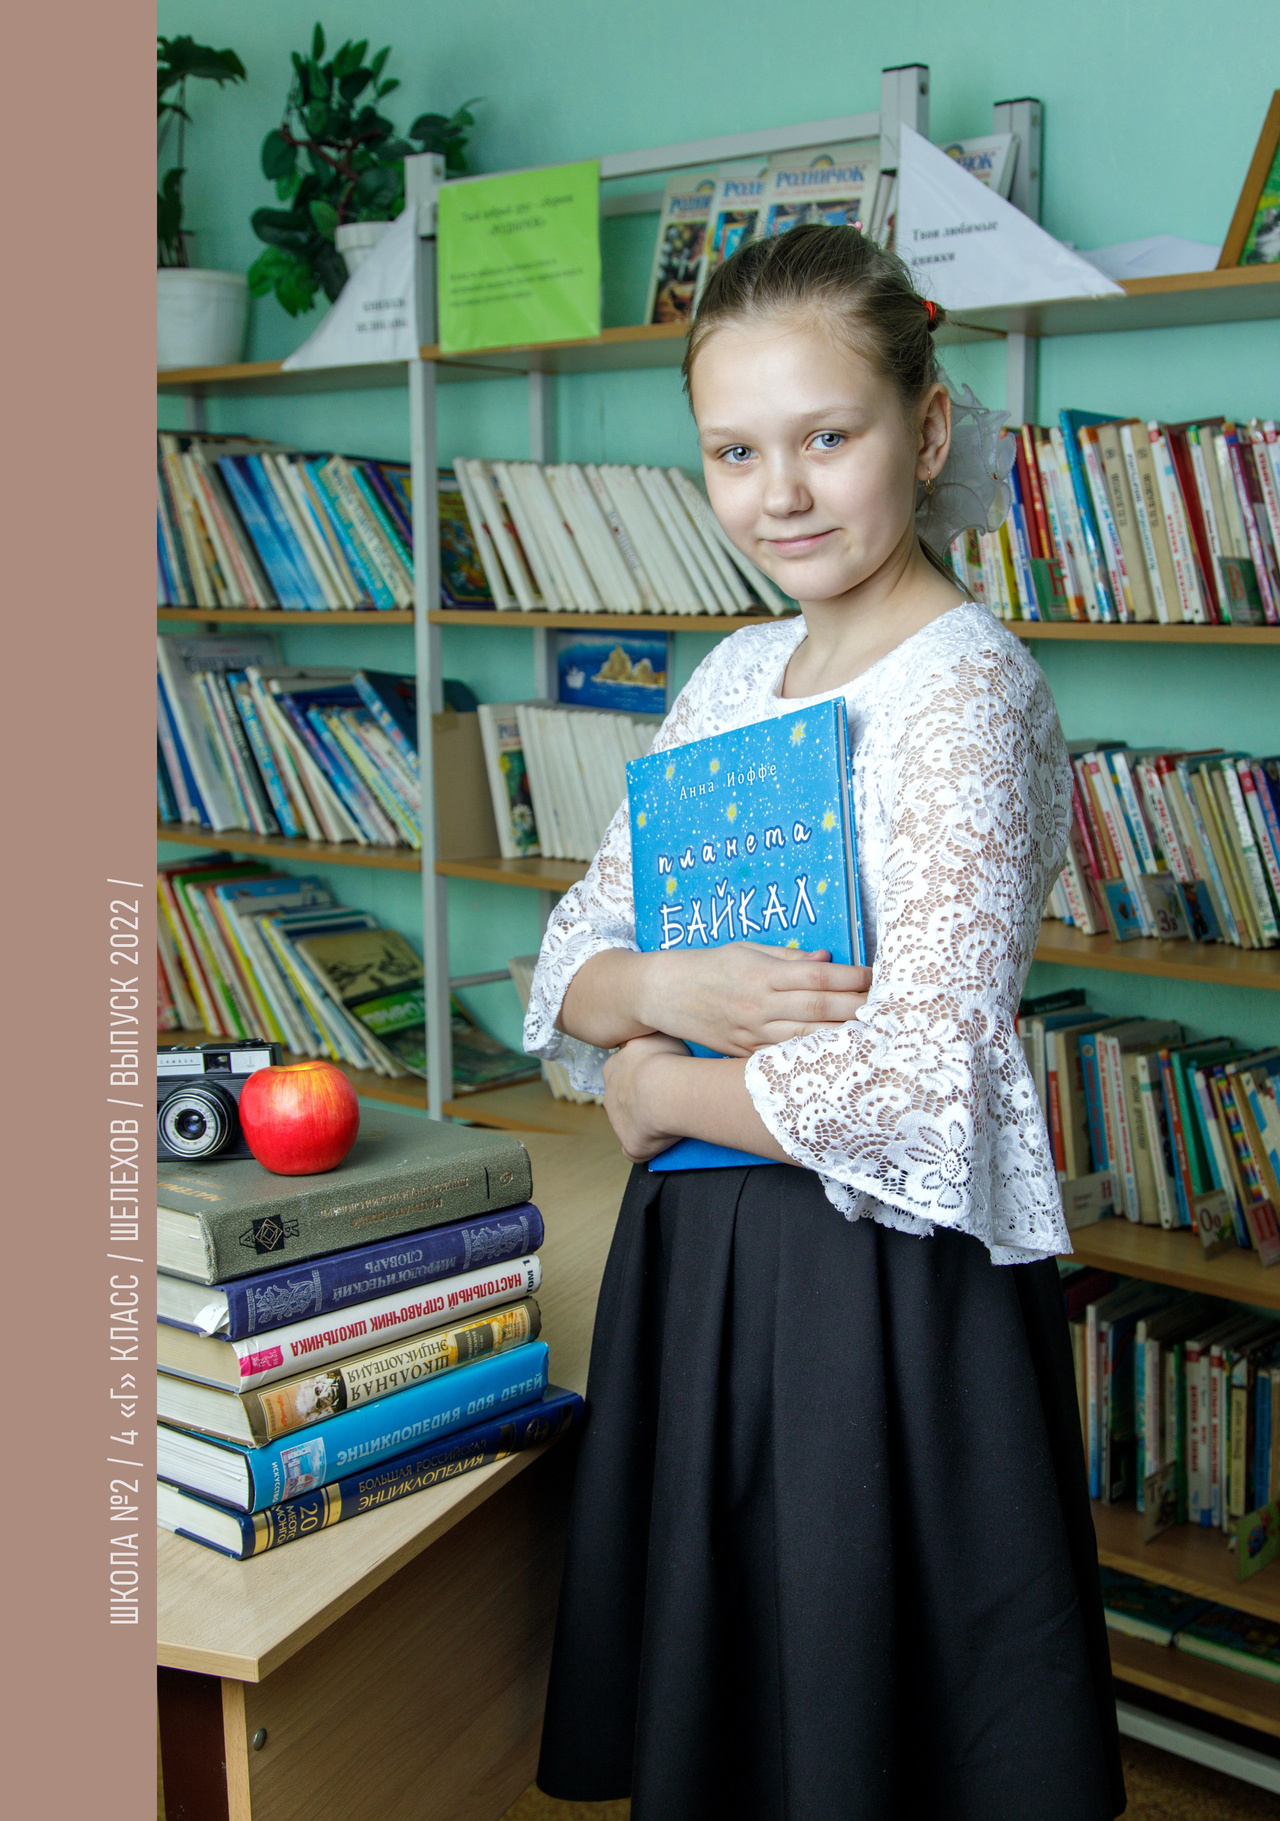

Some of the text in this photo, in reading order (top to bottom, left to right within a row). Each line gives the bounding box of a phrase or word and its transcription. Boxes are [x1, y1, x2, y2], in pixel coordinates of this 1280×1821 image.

[678, 763, 778, 801] Анна Иоффе
[659, 873, 817, 951] БАЙКАЛ
[332, 1256, 457, 1302] МИФОЛОГИЧЕСКИЙ
[365, 1249, 424, 1275] СЛОВАРЬ
[522, 1258, 535, 1295] ТОМ 1
[290, 1272, 522, 1357] НАСТОЛЬНЫЙ СПРАВОЧНИК ШКОЛЬНИКА
[346, 1338, 448, 1384] ЭНЦИКЛОПЕДИЯ
[350, 1354, 450, 1402] ШКОЛЬНАЯ
[336, 1371, 543, 1466] ЭНЦИКЛОПЕДИЯ ДЛЯ ДЕТЕЙ
[357, 1452, 486, 1511] ЭНЦИКЛОПЕДИЯ
[358, 1438, 487, 1493] БОЛЬШАЯ РОССИЙСКАЯ
[299, 1502, 319, 1532] 20
